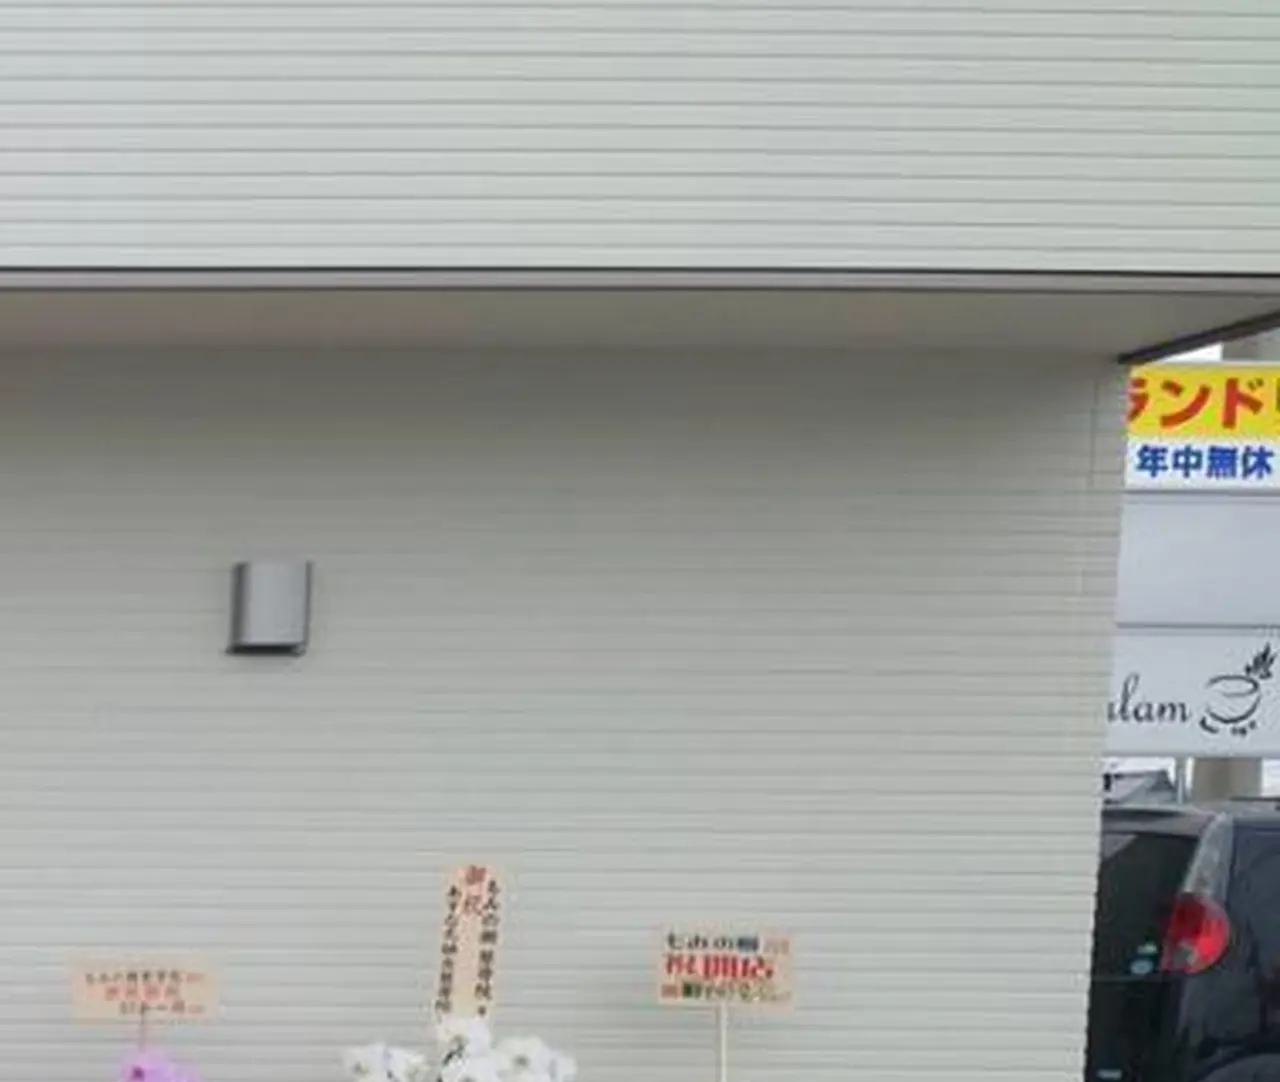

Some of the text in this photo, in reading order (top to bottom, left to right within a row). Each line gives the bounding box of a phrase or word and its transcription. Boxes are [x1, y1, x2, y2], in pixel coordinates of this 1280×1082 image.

[1127, 375, 1280, 430] ランド
[1135, 443, 1276, 480] 年中無休
